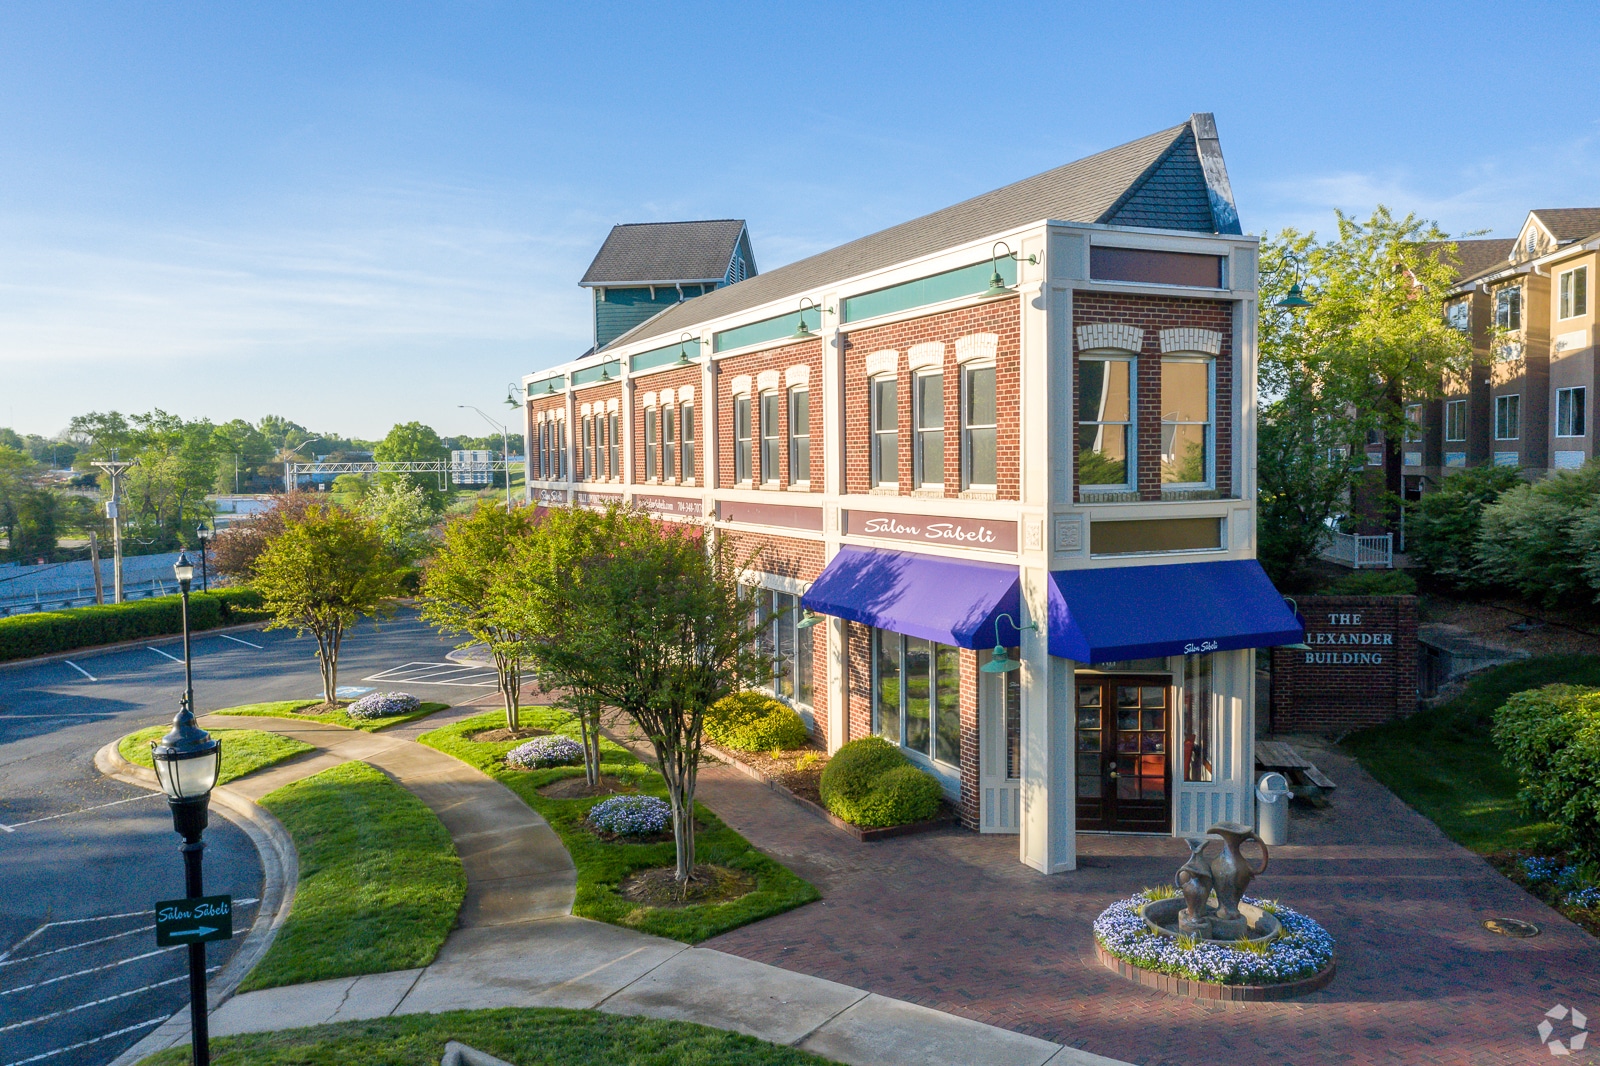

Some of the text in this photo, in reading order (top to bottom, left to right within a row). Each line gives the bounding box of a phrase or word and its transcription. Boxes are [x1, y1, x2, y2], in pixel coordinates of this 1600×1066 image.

[864, 518, 996, 543] Salon Sabeli
[1328, 613, 1362, 625] THE
[1303, 633, 1393, 645] LEXANDER
[1184, 640, 1218, 654] Salon Sabeli
[1304, 652, 1382, 665] BUILDING
[158, 901, 230, 923] Salon Sabeli
